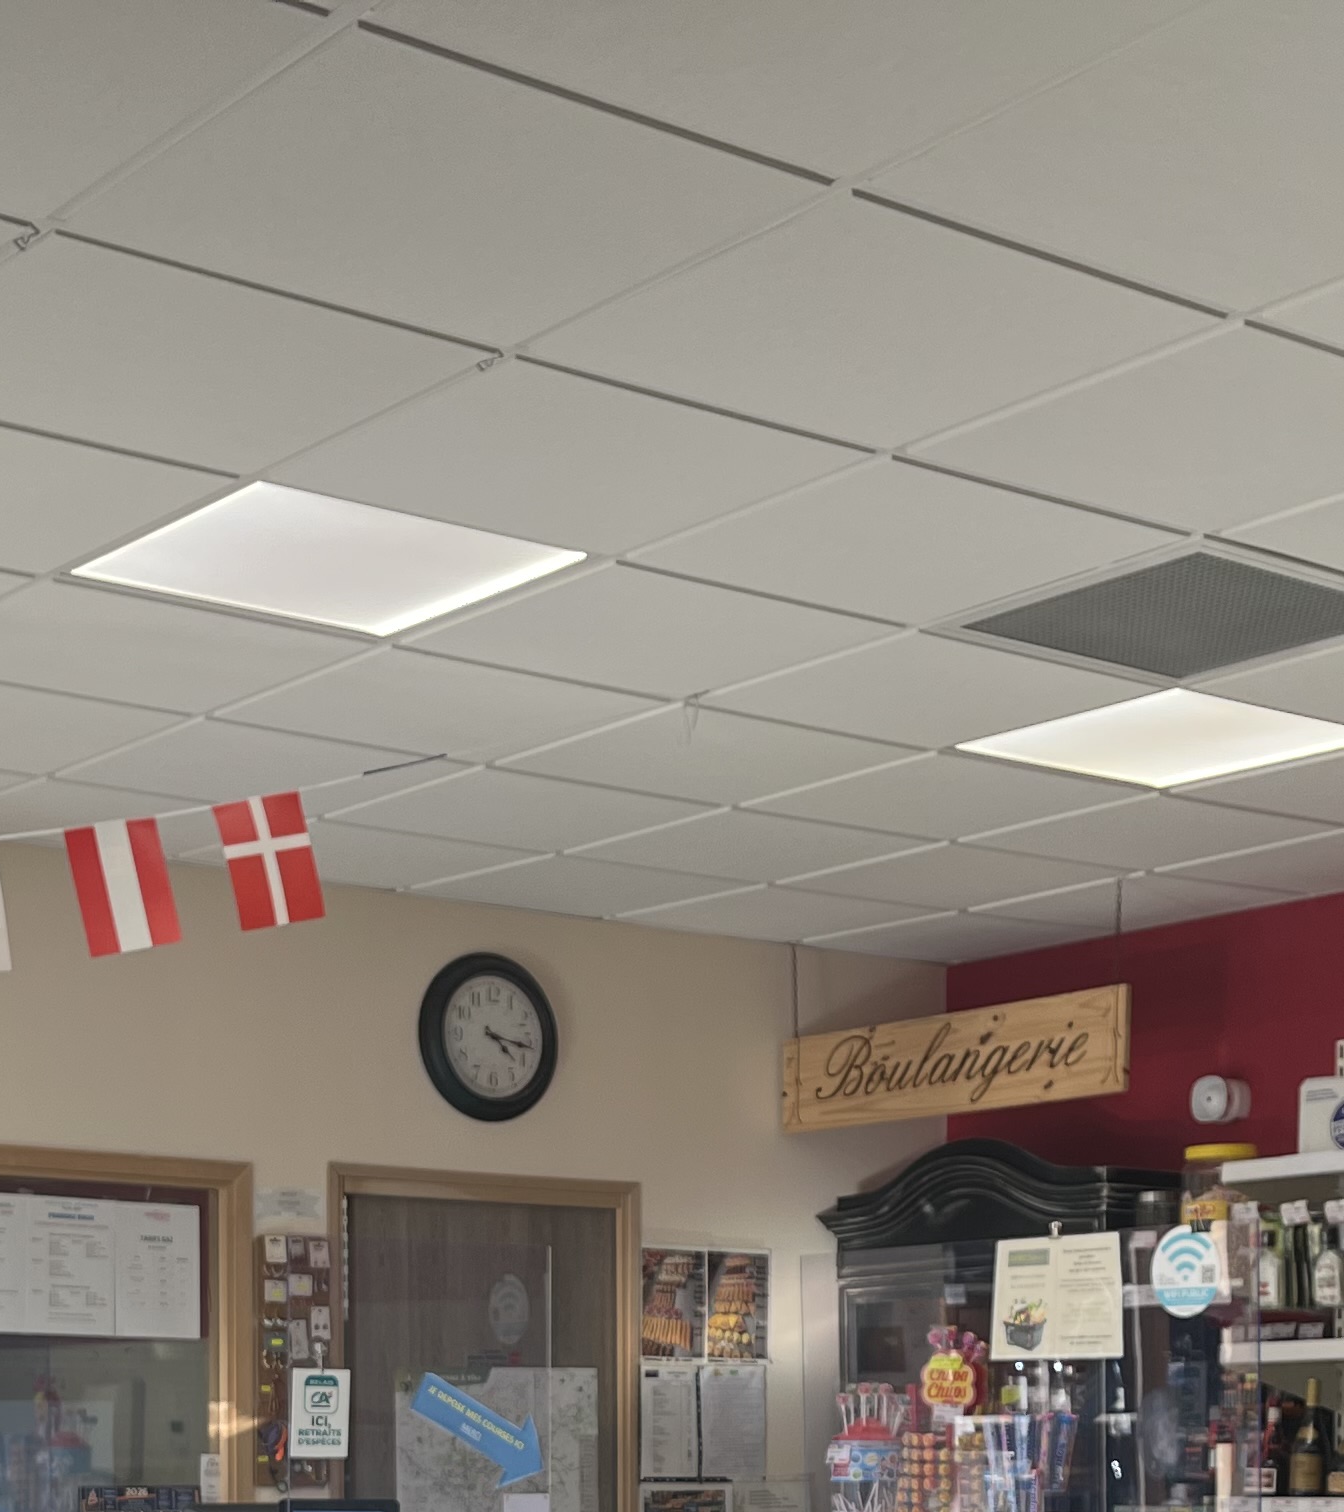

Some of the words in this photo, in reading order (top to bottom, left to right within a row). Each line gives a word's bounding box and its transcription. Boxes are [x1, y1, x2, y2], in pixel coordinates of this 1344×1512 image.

[471, 991, 481, 1007] 11
[458, 1005, 471, 1020] 10
[815, 1022, 1090, 1104] Boulangerie
